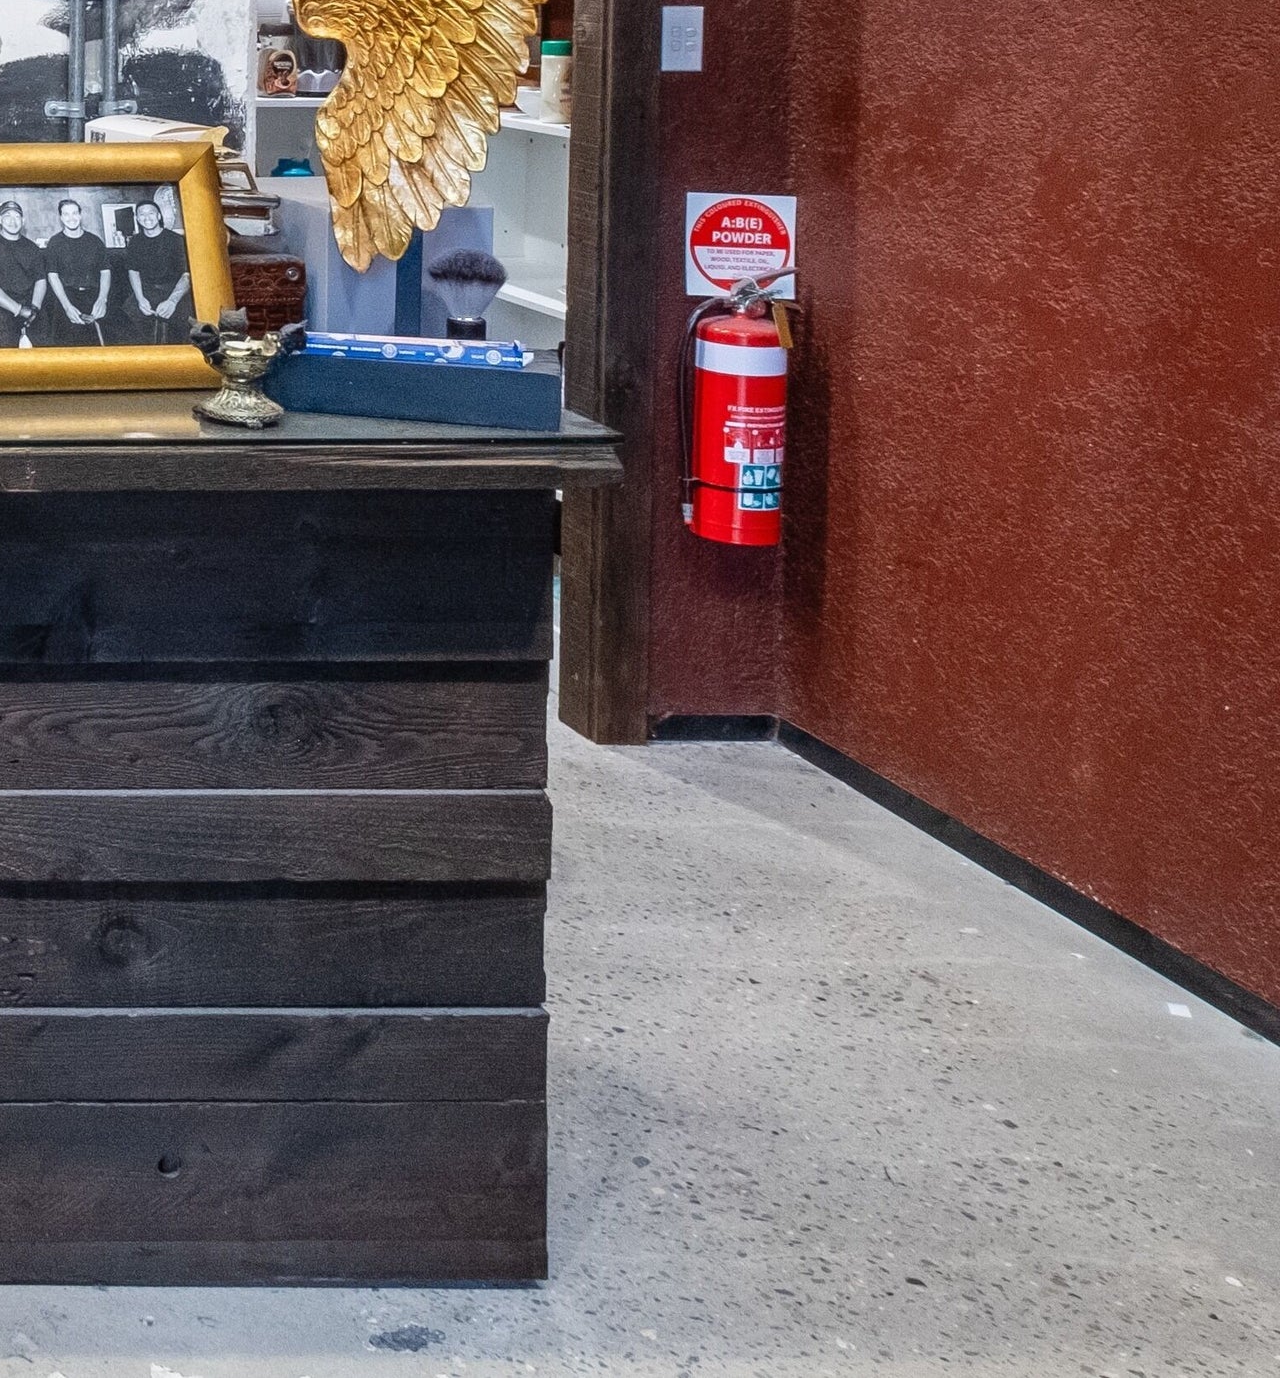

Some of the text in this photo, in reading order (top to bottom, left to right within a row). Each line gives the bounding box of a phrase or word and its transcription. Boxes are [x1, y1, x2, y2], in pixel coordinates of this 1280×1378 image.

[694, 199, 787, 235] THIS COLOURED EXTINGUISHER
[721, 216, 763, 231] A:B(E)
[712, 231, 772, 245] POWDER
